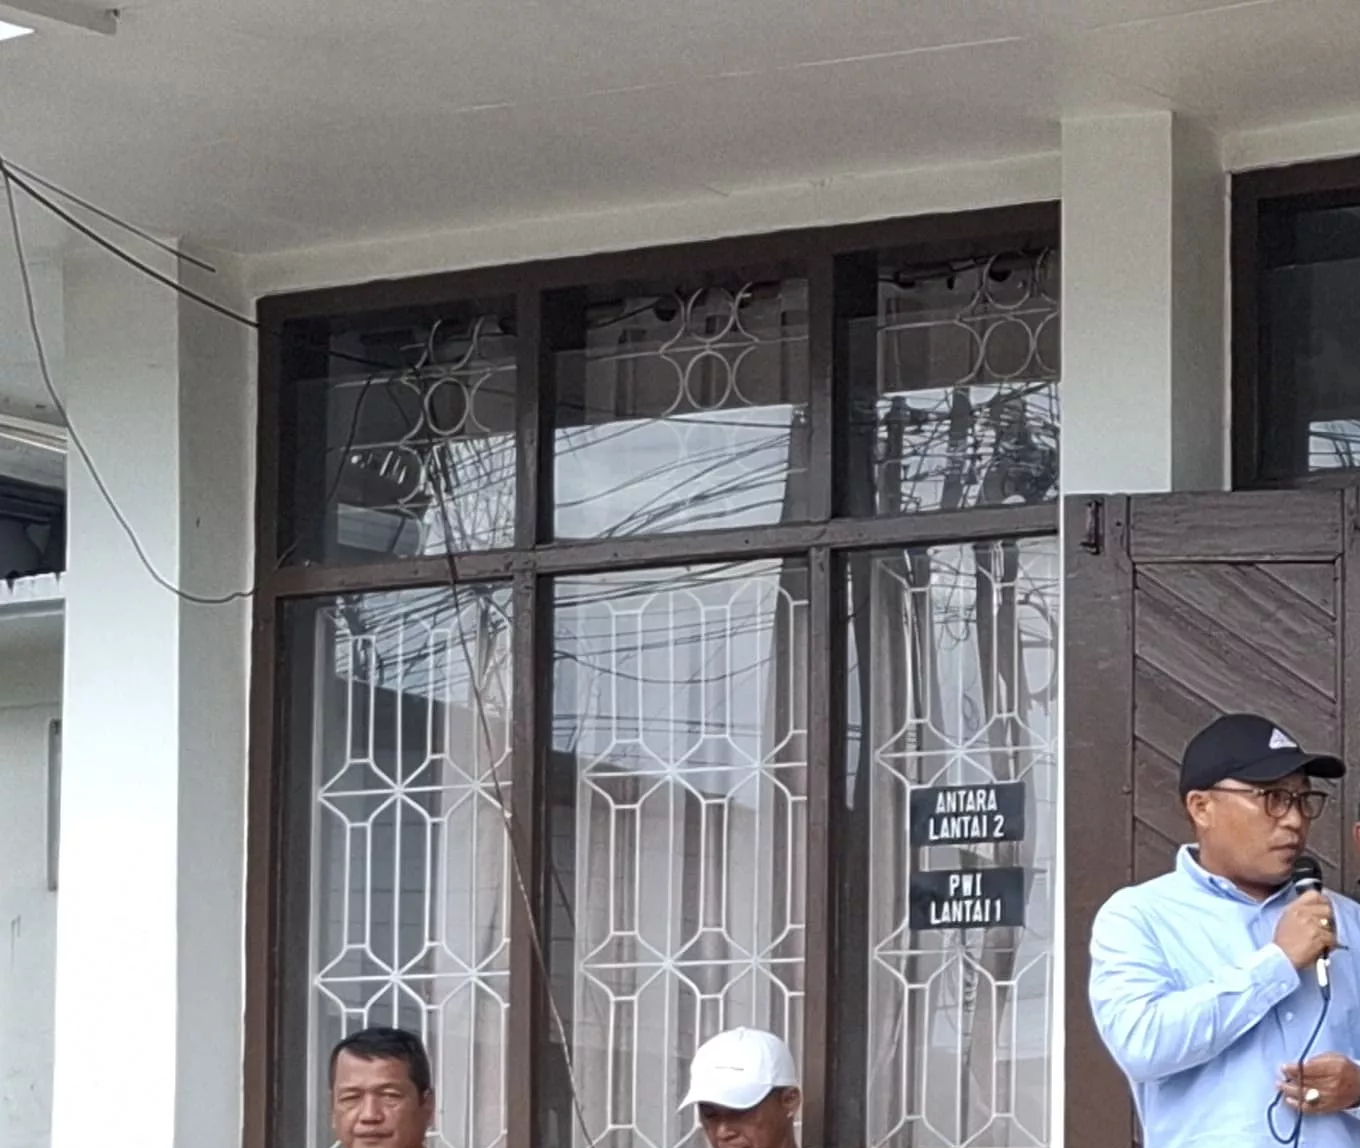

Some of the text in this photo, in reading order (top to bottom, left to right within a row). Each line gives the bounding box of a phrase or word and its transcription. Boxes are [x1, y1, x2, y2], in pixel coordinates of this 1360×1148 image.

[935, 789, 998, 814] ANTARA
[928, 814, 1005, 841] LANTAI 2
[949, 872, 982, 897] PWI
[929, 897, 1002, 925] LANTAI 1
